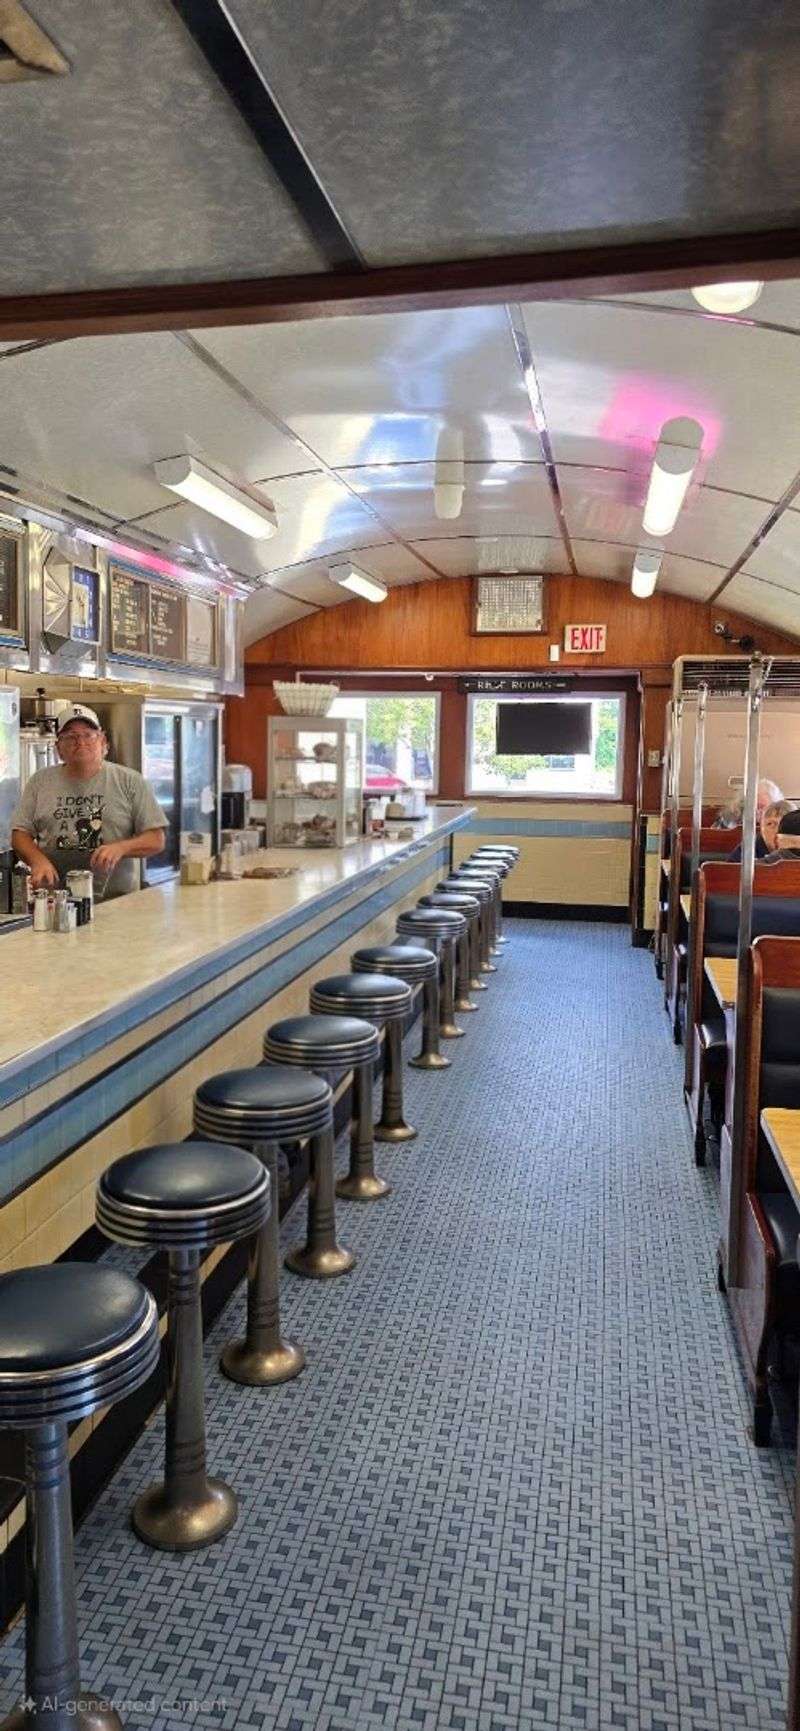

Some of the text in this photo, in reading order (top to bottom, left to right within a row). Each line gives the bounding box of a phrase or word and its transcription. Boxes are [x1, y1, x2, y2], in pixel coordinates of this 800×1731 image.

[571, 627, 603, 650] EXIT
[53, 807, 85, 820] GIVE
[60, 820, 69, 831] A
